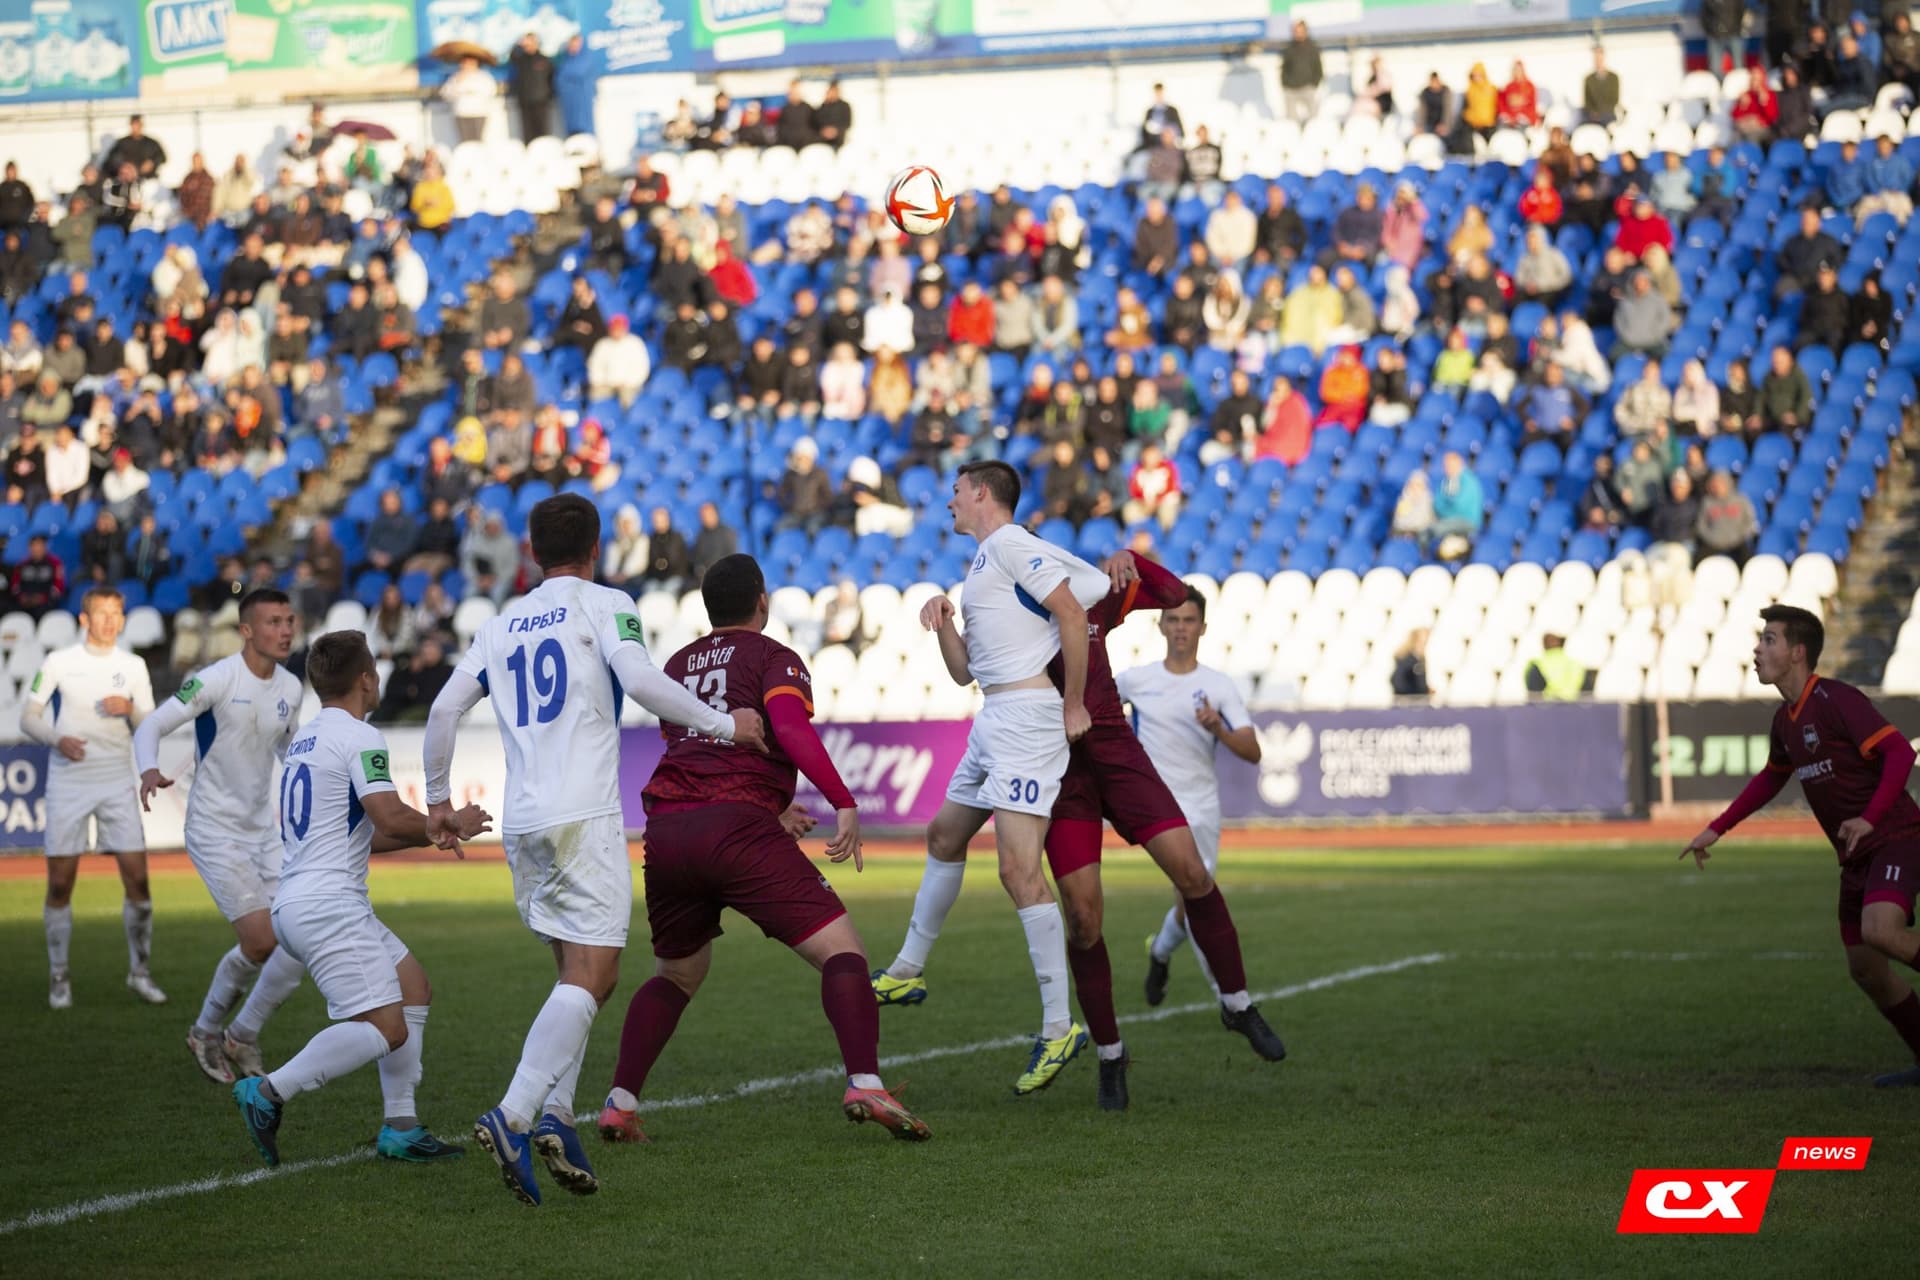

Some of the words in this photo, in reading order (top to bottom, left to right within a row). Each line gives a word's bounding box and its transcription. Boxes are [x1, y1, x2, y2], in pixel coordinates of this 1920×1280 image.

[508, 607, 567, 633] ГАРБУЗ
[687, 646, 736, 673] СЫЧЕВ
[507, 638, 567, 727] 19
[281, 763, 312, 842] 10
[1009, 778, 1039, 804] 30
[1885, 864, 1901, 881] 11
